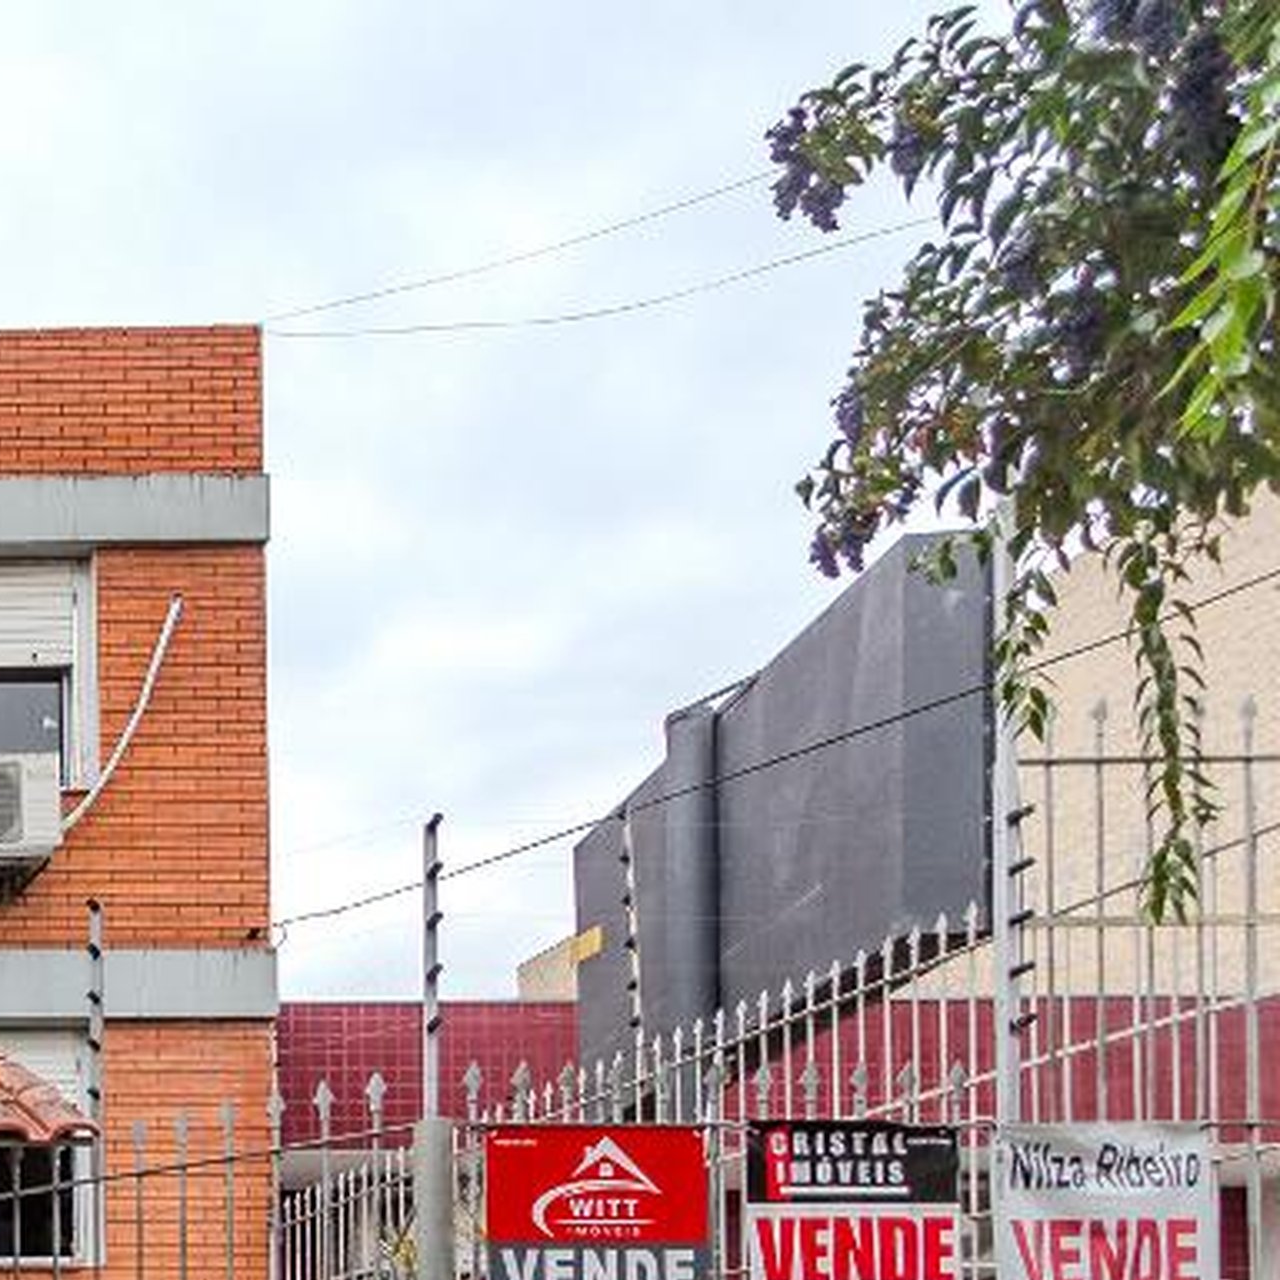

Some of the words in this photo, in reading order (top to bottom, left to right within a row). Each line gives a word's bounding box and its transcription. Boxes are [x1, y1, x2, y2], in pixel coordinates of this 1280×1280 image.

[770, 1131, 908, 1155] CRISTAL
[775, 1157, 905, 1184] IMÓVEIS
[1009, 1142, 1084, 1190] Nilza
[1096, 1142, 1201, 1190] Ribeiro
[568, 1198, 639, 1218] WITT
